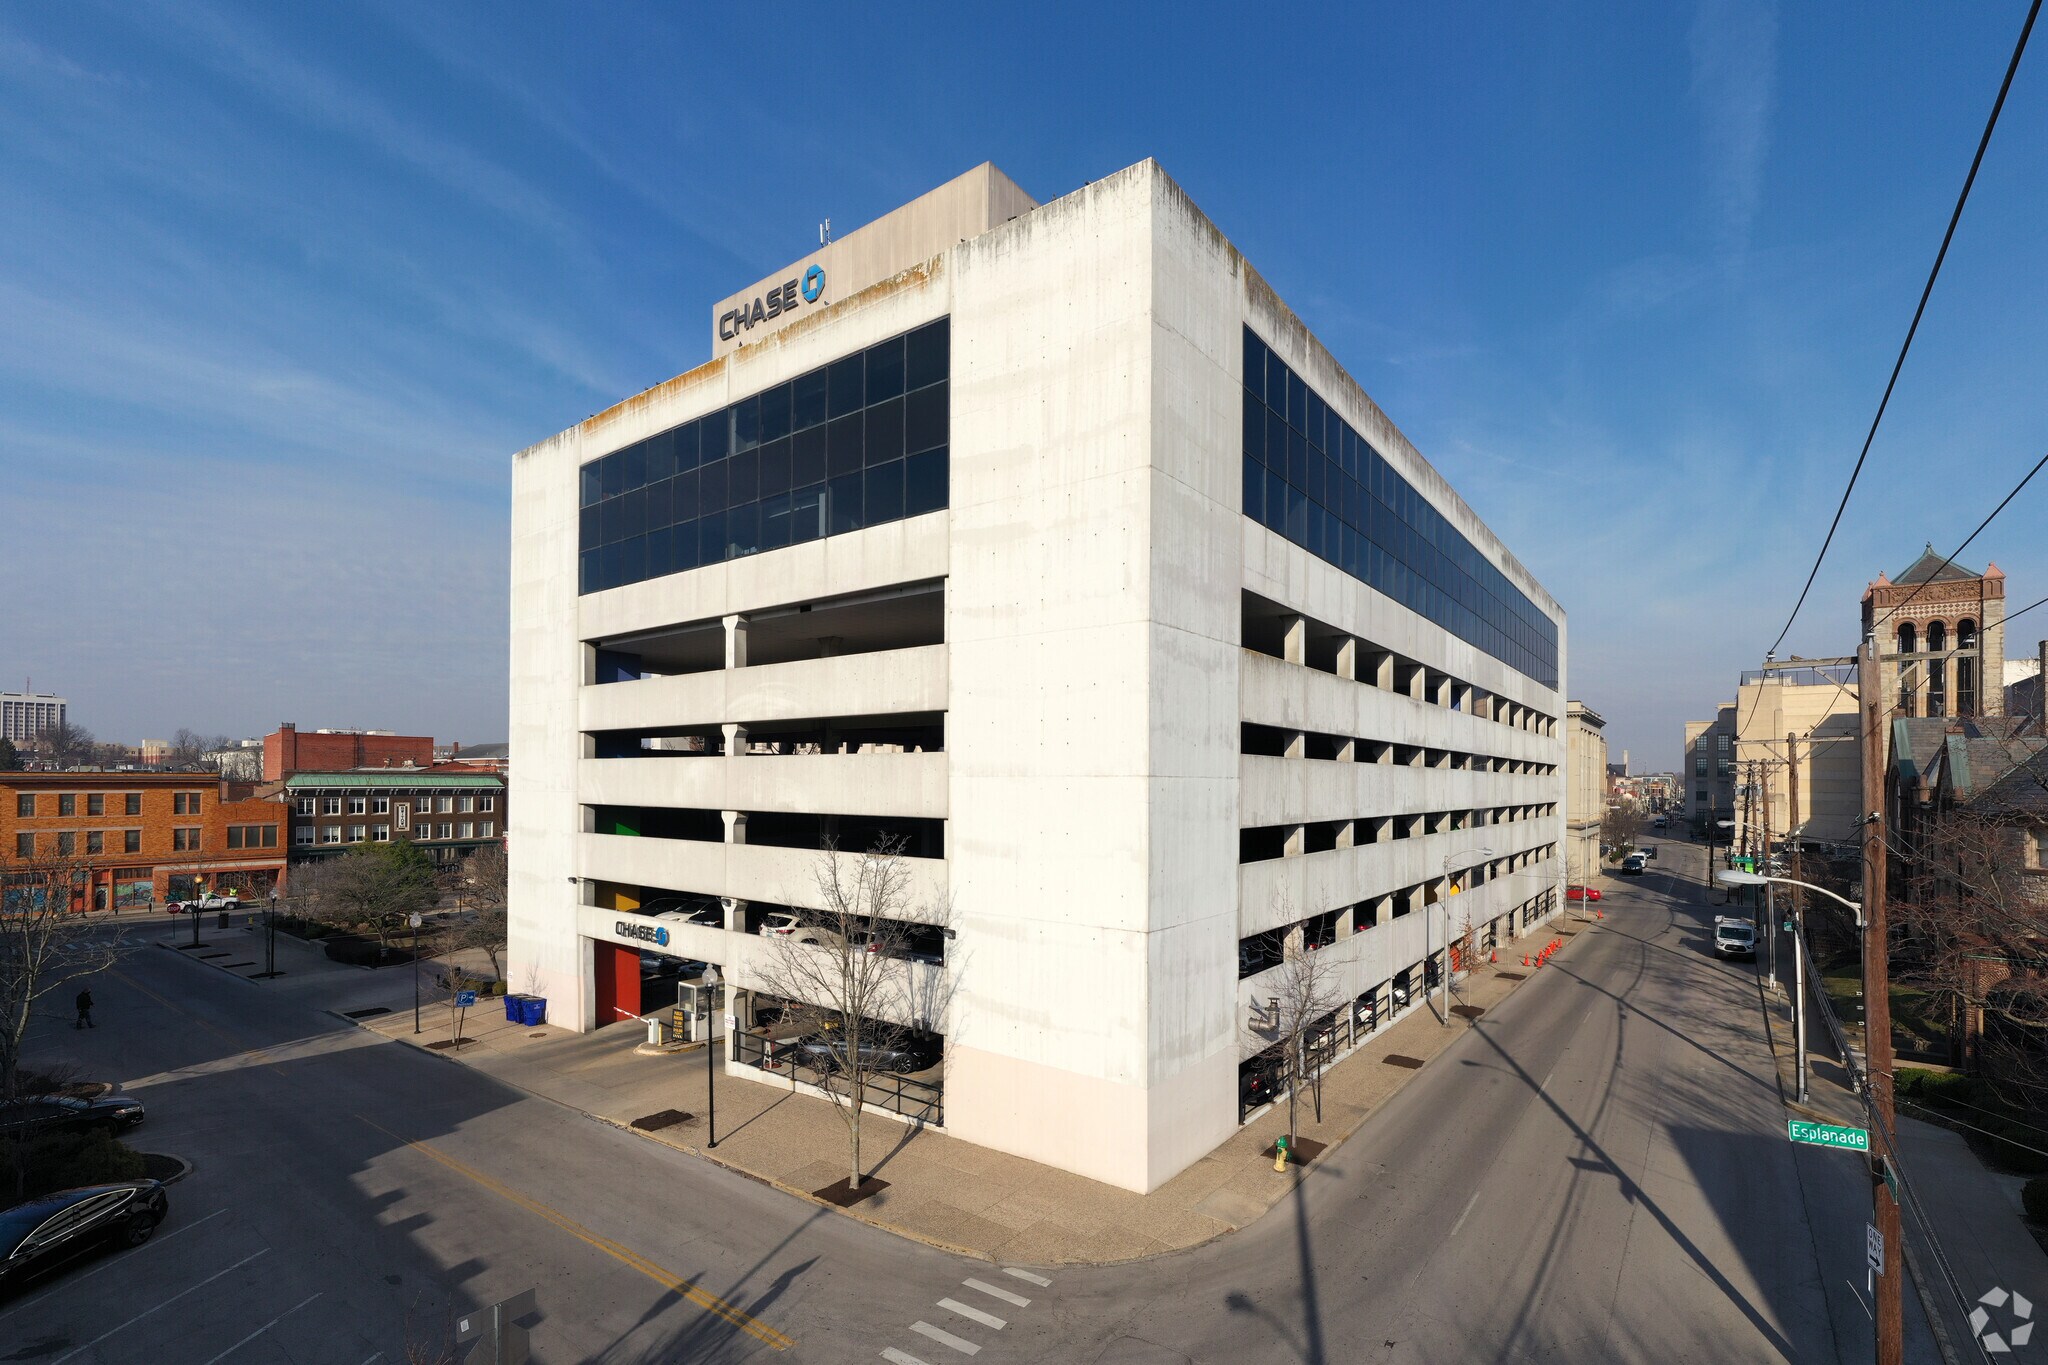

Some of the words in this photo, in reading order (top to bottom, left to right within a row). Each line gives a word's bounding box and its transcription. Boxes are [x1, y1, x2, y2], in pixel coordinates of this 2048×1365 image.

[719, 278, 799, 341] CHASE
[616, 921, 658, 943] CHASE
[1792, 1124, 1865, 1146] Esplanade
[1868, 1228, 1882, 1247] ONE
[1868, 1240, 1882, 1258] WAY
